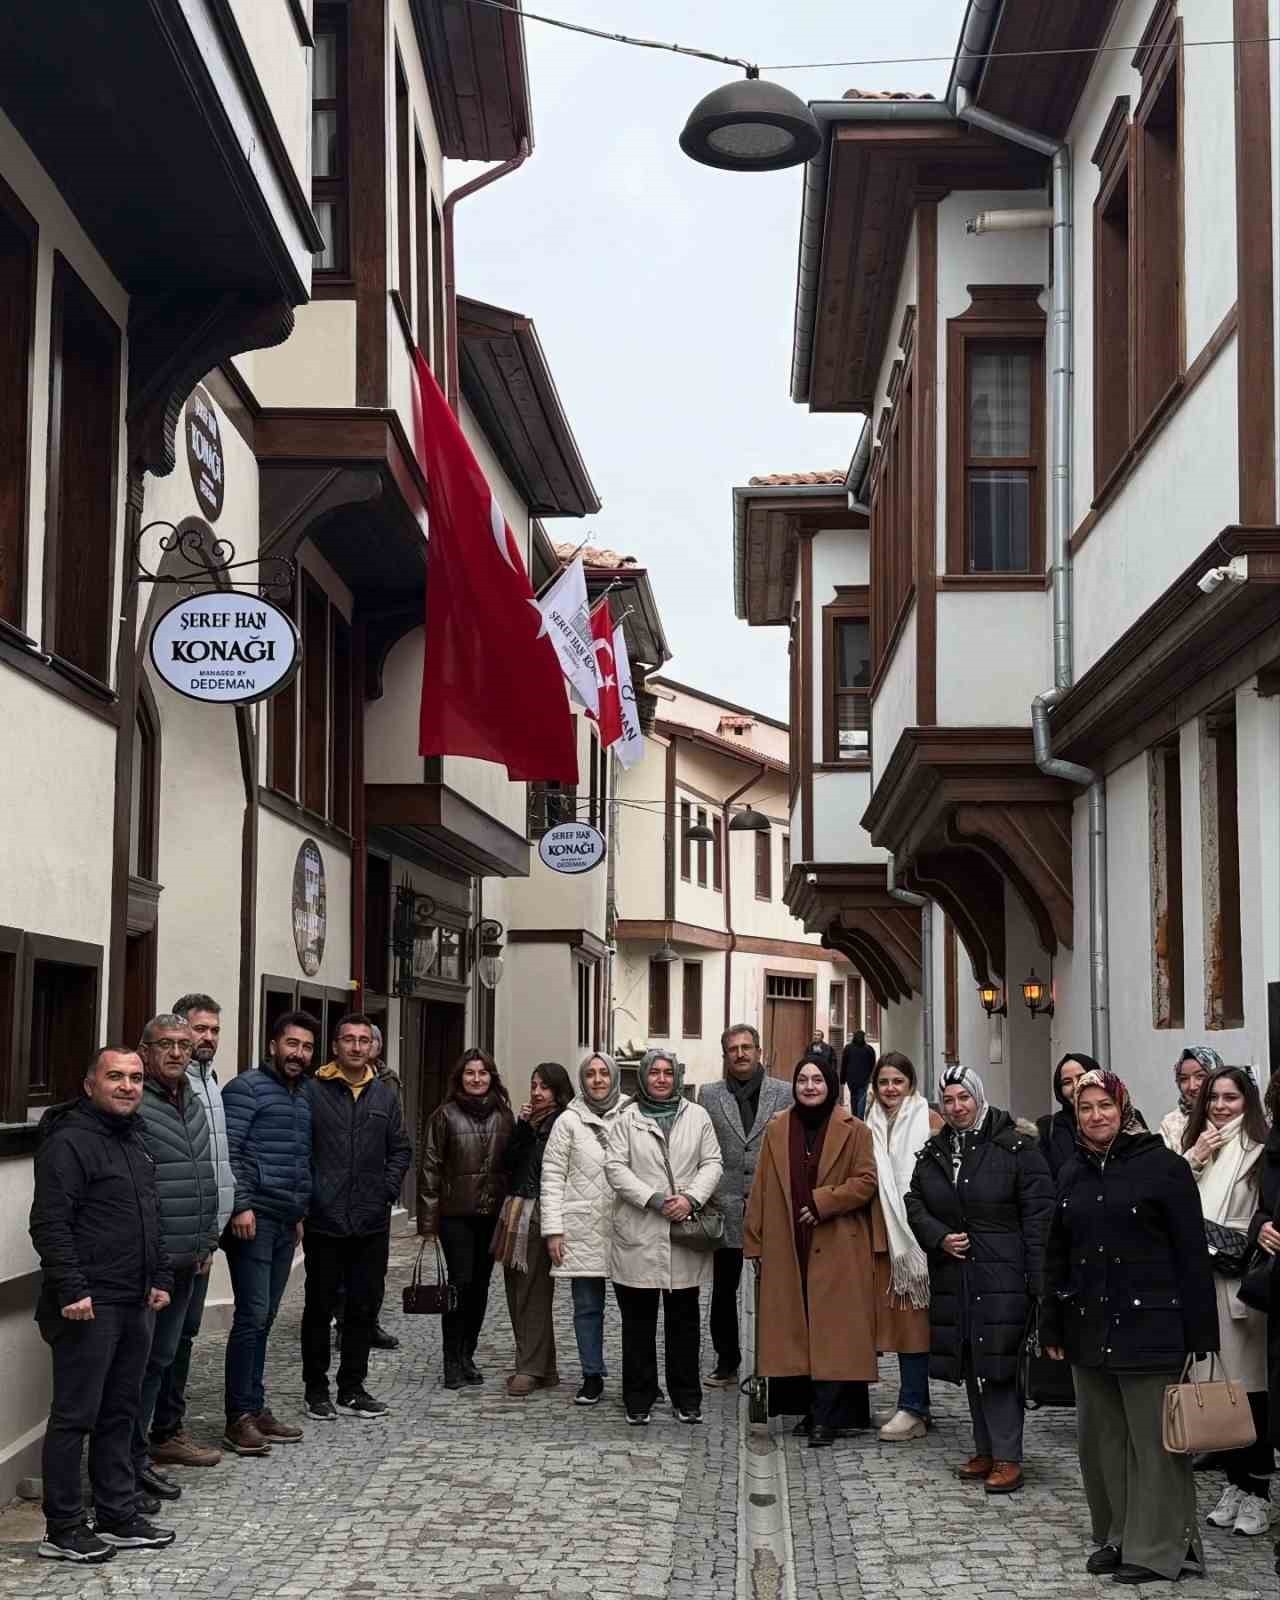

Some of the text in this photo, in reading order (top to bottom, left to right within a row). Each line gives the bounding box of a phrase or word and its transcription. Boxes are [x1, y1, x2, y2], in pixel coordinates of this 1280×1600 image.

[180, 612, 267, 630] ŞEREF HAN
[171, 635, 276, 663] KONAĞI
[190, 679, 255, 690] DEDEMAN
[548, 842, 594, 856] KONAĞI
